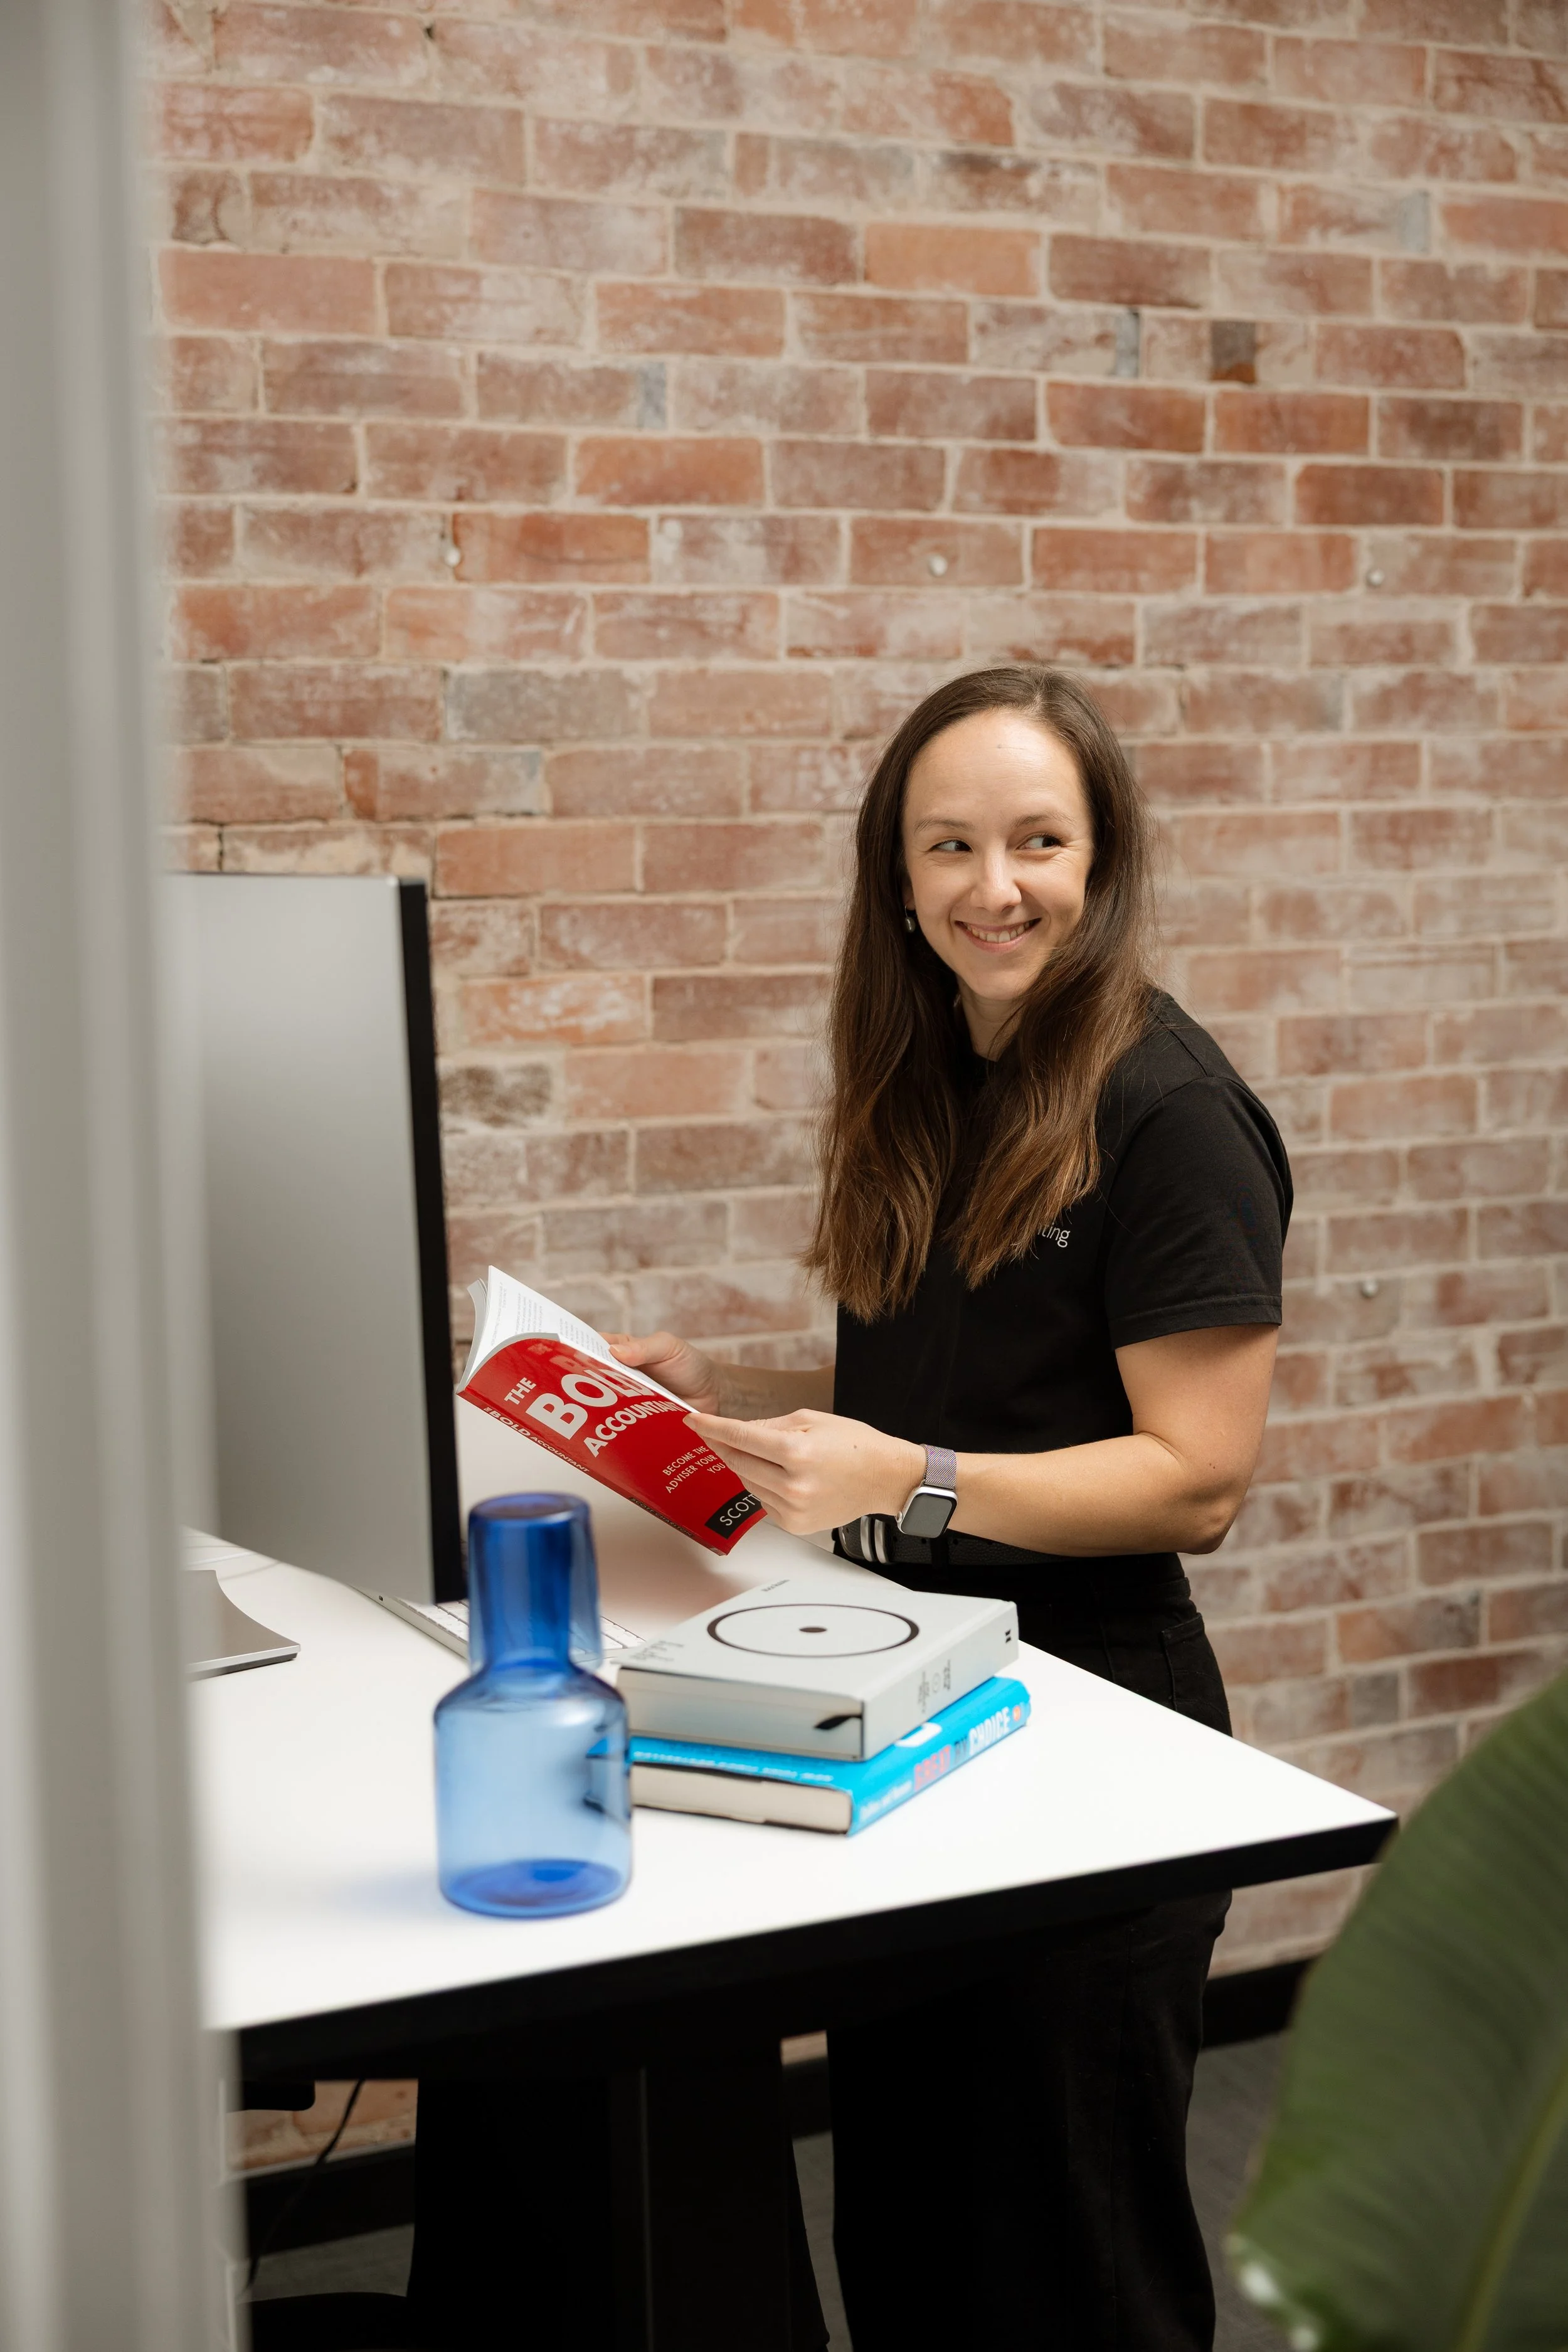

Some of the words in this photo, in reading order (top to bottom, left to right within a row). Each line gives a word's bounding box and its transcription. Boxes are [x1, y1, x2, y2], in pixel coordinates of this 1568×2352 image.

[504, 1377, 536, 1405] THE
[526, 1369, 657, 1440] BOLD
[489, 1410, 531, 1436] BOLD
[531, 1436, 590, 1472] ACCOUNTANT
[583, 1401, 688, 1458] ACCOUNTANT
[662, 1452, 696, 1476] BECOME
[692, 1446, 709, 1455] THE
[665, 1465, 698, 1493] ADVISER
[695, 1454, 718, 1467] YOUR
[707, 1463, 726, 1473] YOU
[720, 1493, 761, 1526] SCOTT
